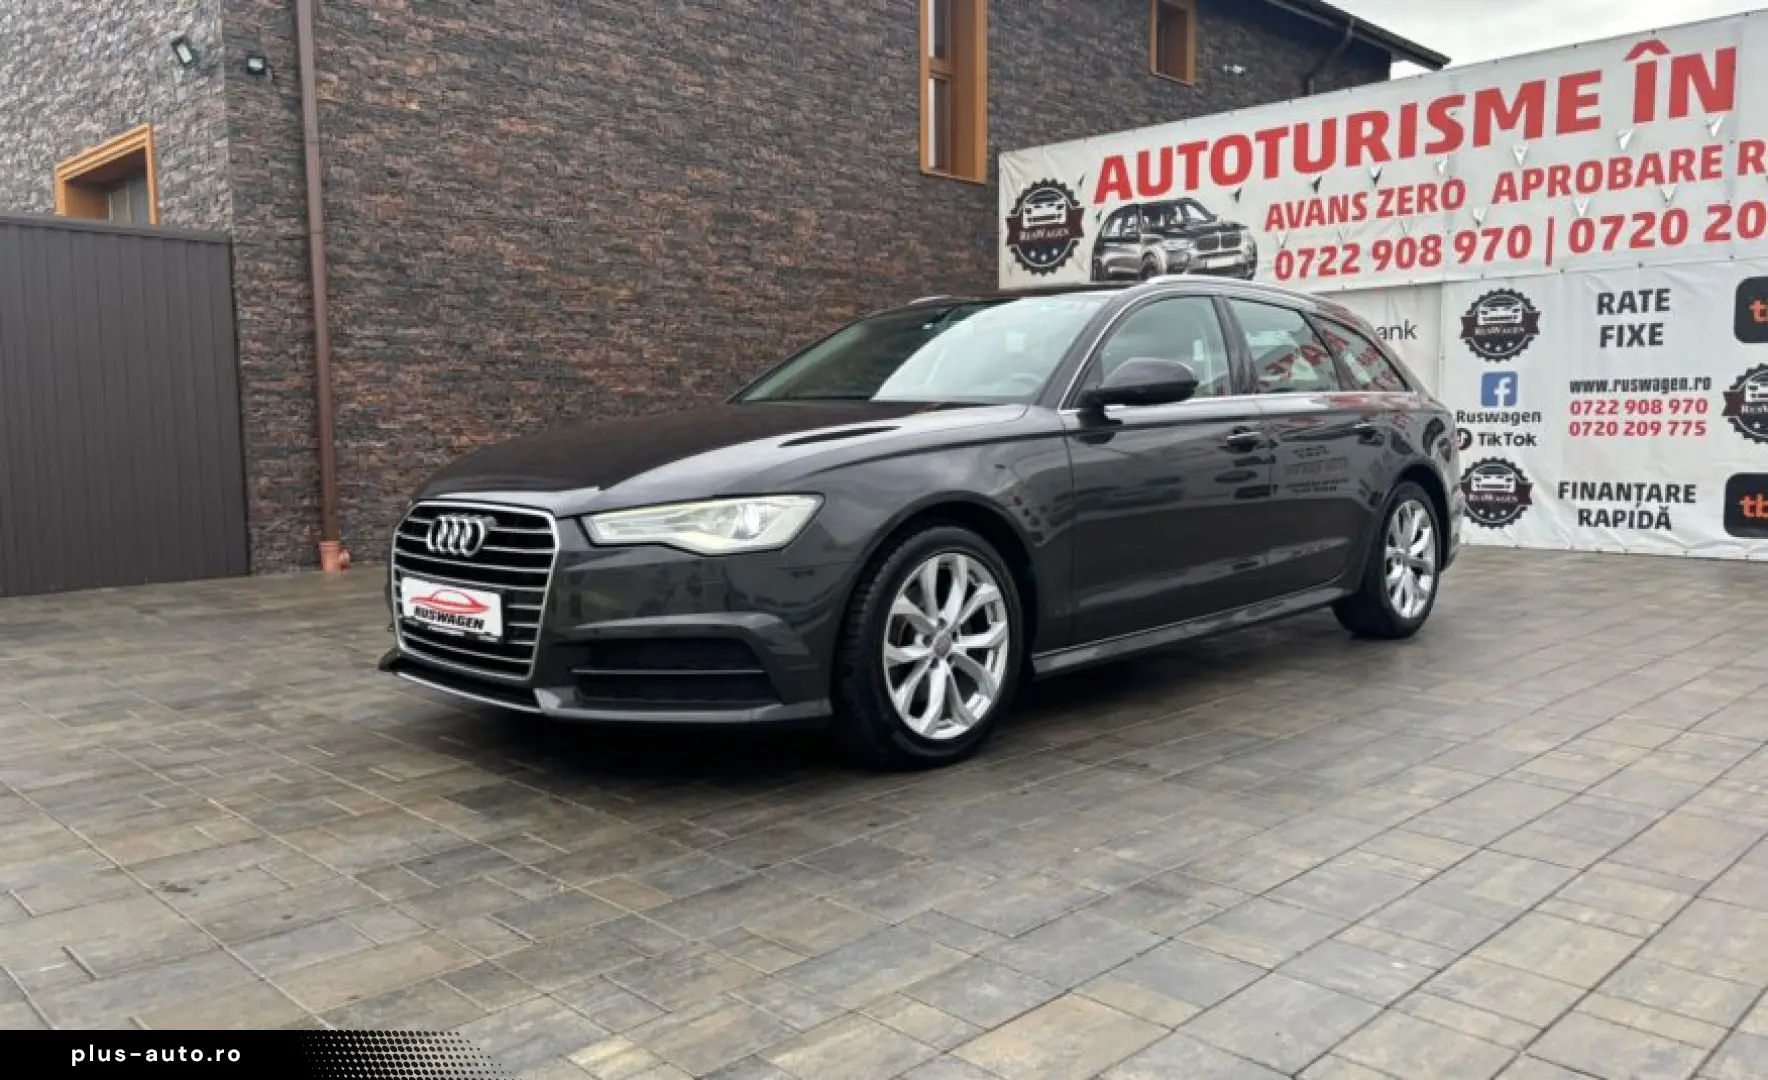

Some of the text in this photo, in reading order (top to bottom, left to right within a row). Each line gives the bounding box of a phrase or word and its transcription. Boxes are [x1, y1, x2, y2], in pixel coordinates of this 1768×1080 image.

[1092, 39, 1737, 206] AUTOTURISME ÎN
[1264, 193, 1368, 230] AVANS
[1376, 178, 1467, 219] ZERO
[1490, 144, 1725, 204] APROBARE
[1274, 239, 1362, 281] 0722
[1371, 234, 1442, 271] 908
[1453, 224, 1532, 264] 970
[1568, 207, 1690, 254] 0720
[1702, 200, 1768, 243] 20
[1596, 287, 1671, 316] RATE
[1599, 321, 1665, 348] FIXE
[1569, 376, 1712, 395] www.ruswagen.ro
[1456, 409, 1543, 427] Ruswagen
[1569, 397, 1709, 415] 0722 908 970
[1477, 432, 1538, 447] TikTok
[1568, 420, 1707, 437] 0720 209 775
[1576, 506, 1673, 530] RAPIDĂ
